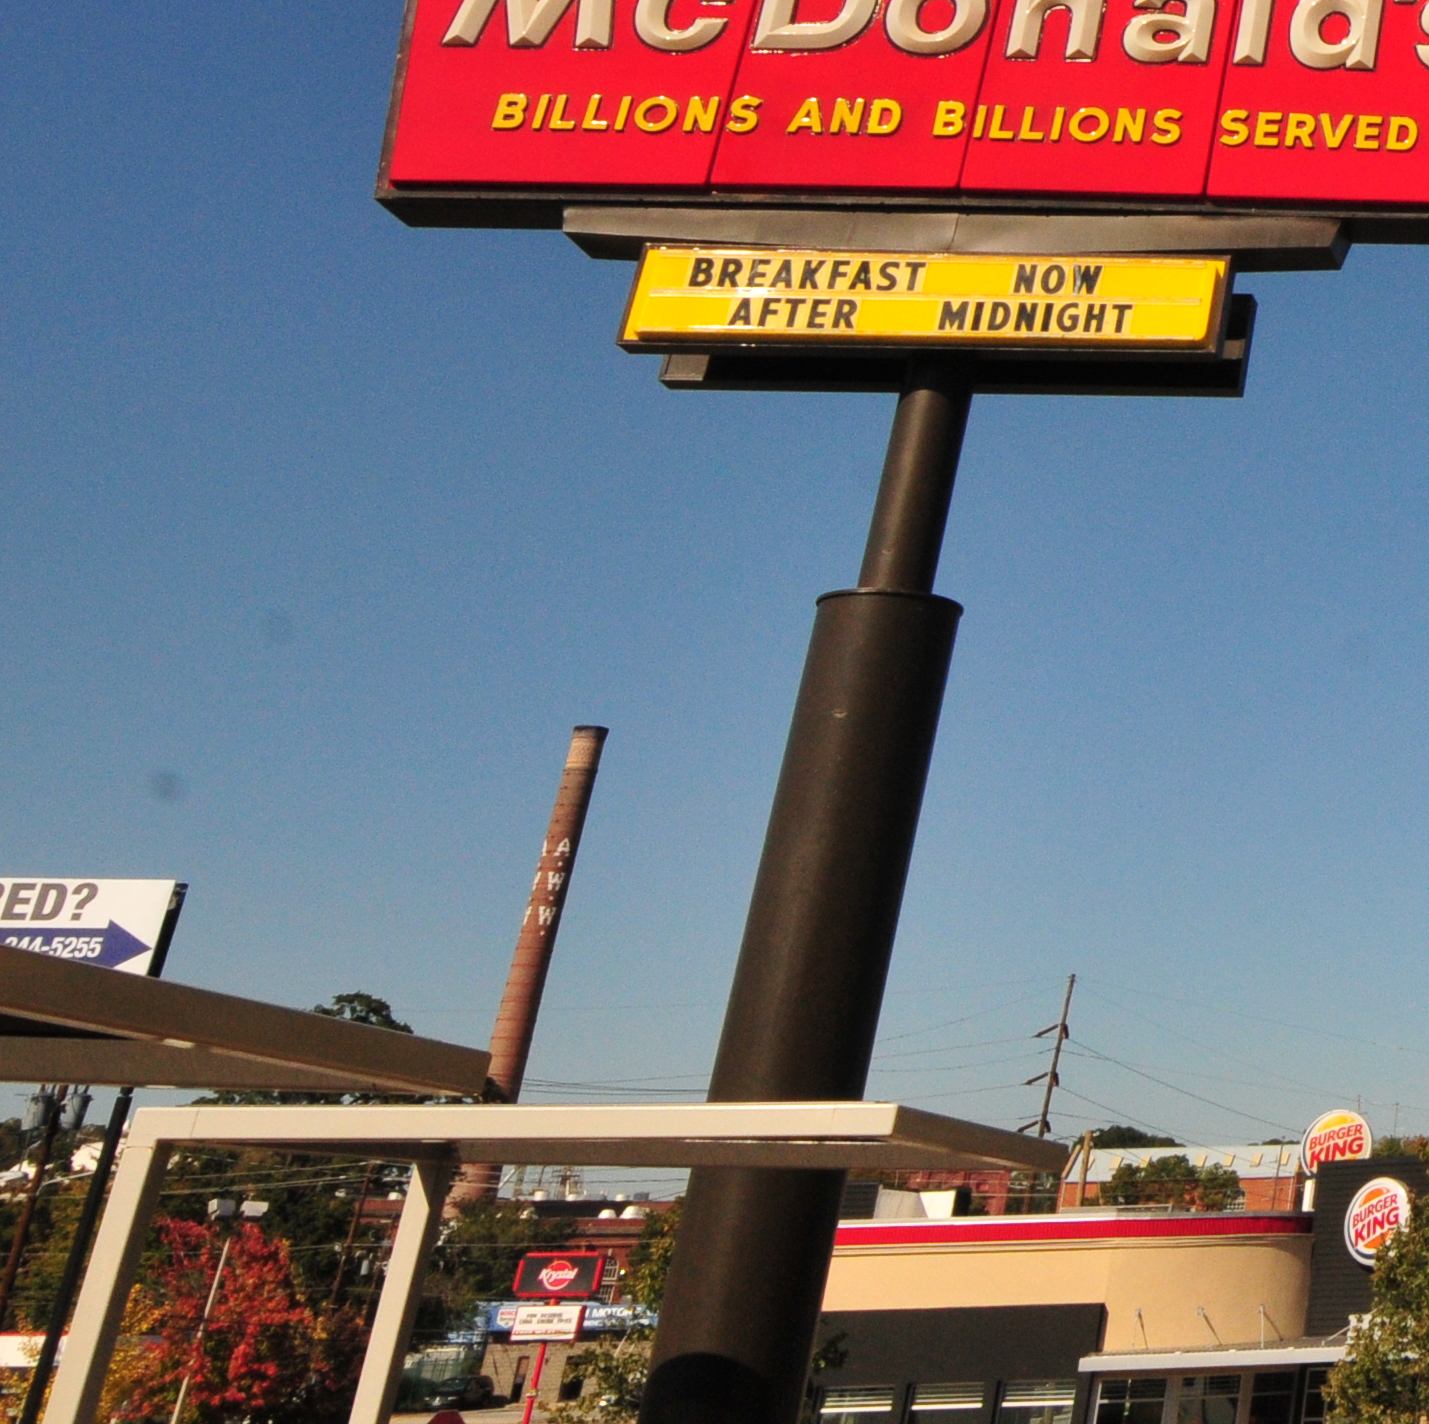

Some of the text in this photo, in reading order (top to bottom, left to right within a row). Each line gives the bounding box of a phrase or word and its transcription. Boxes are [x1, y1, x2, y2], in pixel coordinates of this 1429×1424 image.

[492, 92, 1418, 151] BILLIONS AND BILLIONS SERVED
[688, 258, 1103, 295] BREAKFAST NOW
[727, 297, 1133, 334] AFTER MIDNIGHT
[0, 882, 98, 922] ED?
[1309, 1123, 1364, 1150] BURGER
[1309, 1136, 1364, 1169] KING
[1352, 1194, 1398, 1228] BURGER
[1354, 1207, 1400, 1246] KING
[538, 1267, 579, 1282] Krystal
